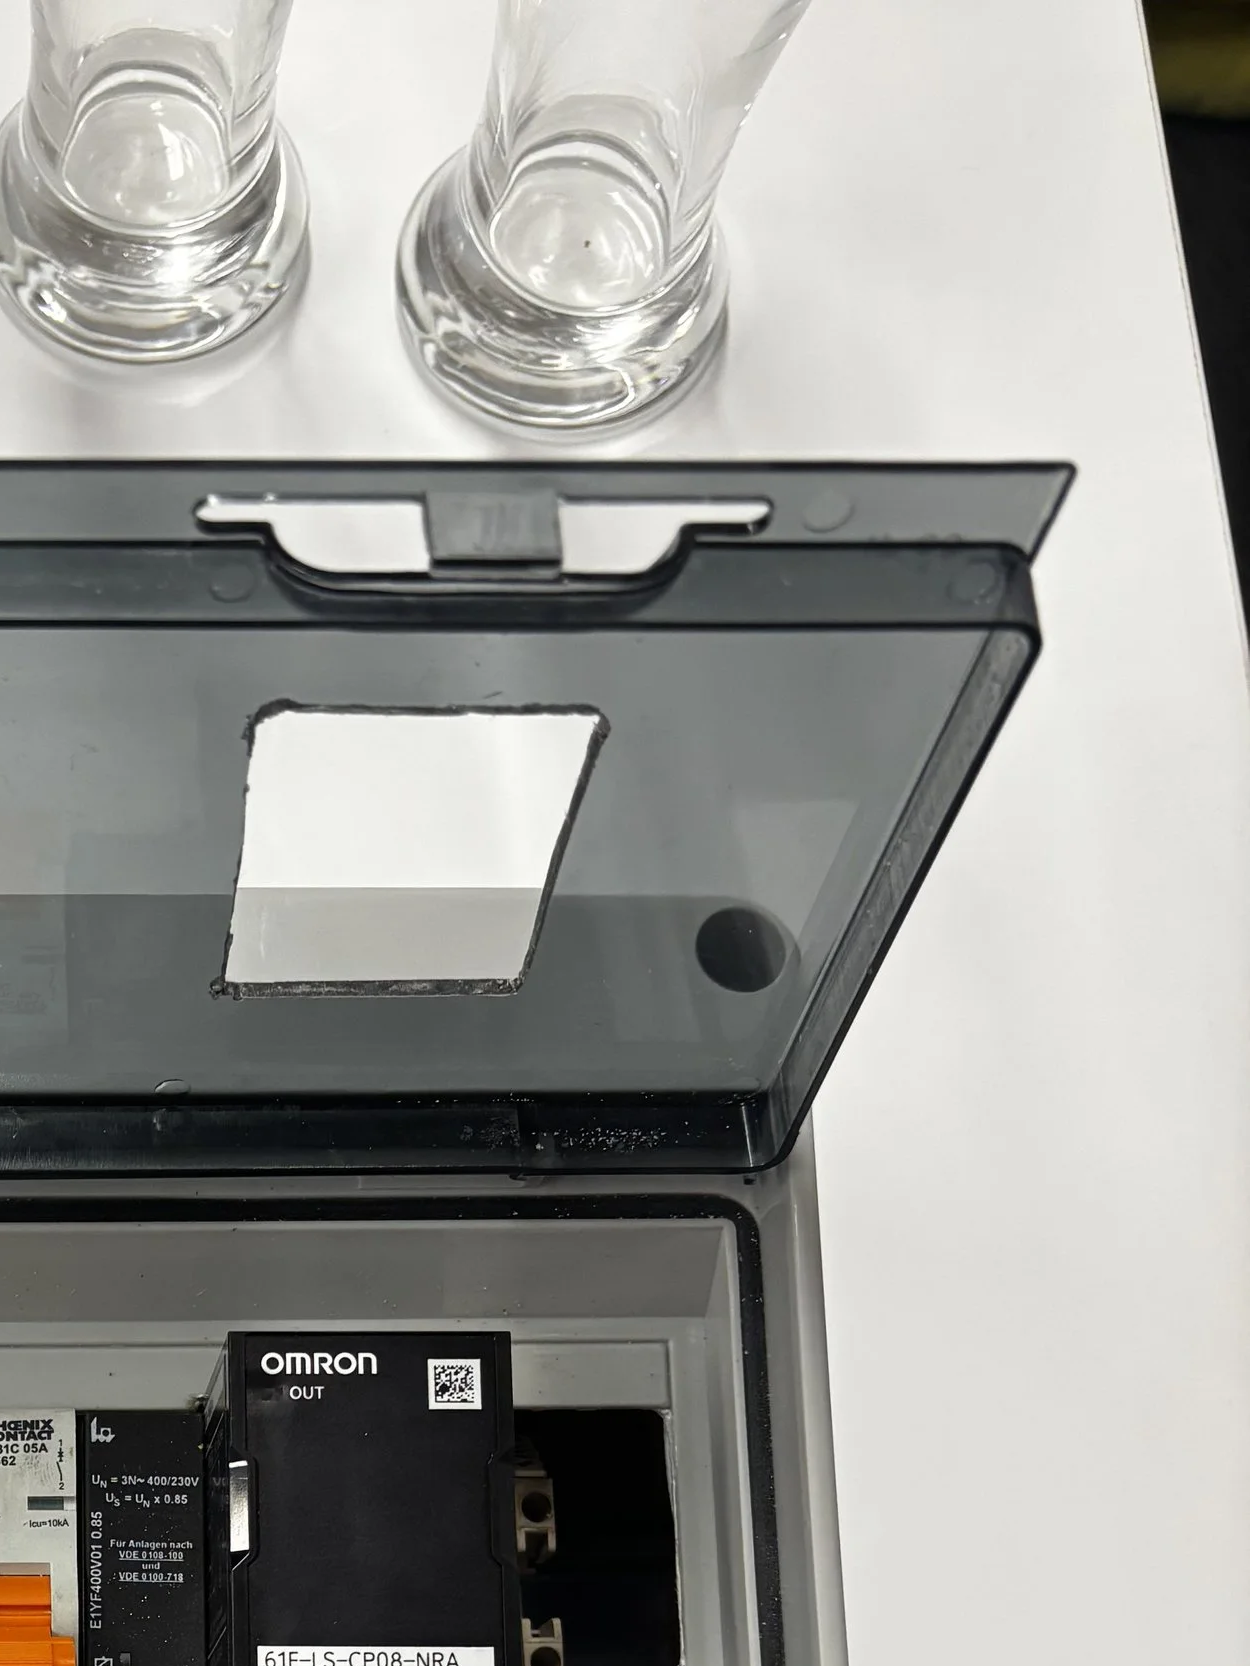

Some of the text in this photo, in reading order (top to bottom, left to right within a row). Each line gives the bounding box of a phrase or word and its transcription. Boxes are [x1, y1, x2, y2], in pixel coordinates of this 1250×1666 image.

[261, 1352, 378, 1375] OMRON
[289, 1386, 325, 1400] OUT
[23, 1443, 48, 1453] 05A
[58, 1482, 65, 1490] 2
[147, 1476, 199, 1487] 400/230V
[164, 1494, 188, 1504] 0.85
[128, 1540, 167, 1550] Anlagen
[170, 1540, 193, 1549] nach
[119, 1551, 139, 1559] VDE
[90, 1511, 103, 1629] E1YF400V01 0.85
[142, 1562, 160, 1570] und
[119, 1572, 139, 1580] VDE
